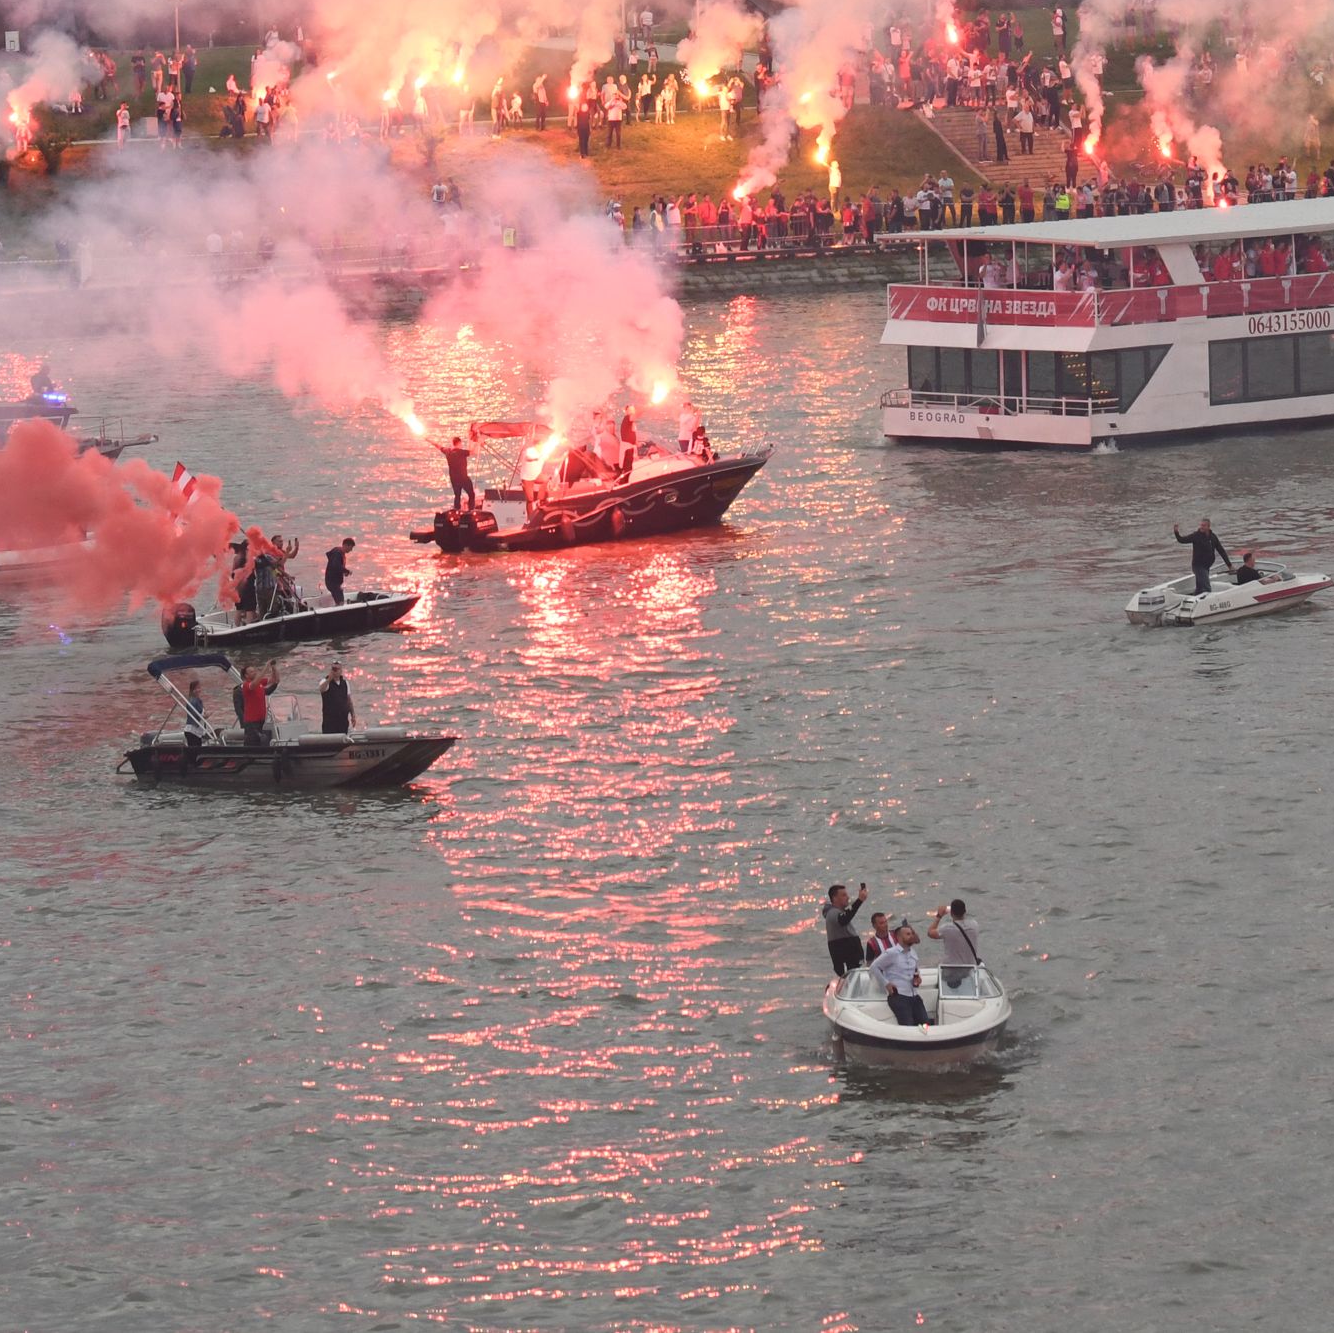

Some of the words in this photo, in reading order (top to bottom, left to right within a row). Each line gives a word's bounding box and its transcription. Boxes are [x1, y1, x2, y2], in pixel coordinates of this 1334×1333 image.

[927, 297, 947, 312] ФК
[1005, 300, 1057, 318] ЗВЕЗДА
[1248, 310, 1331, 334] 0643155000
[910, 411, 965, 424] BEOGRAD
